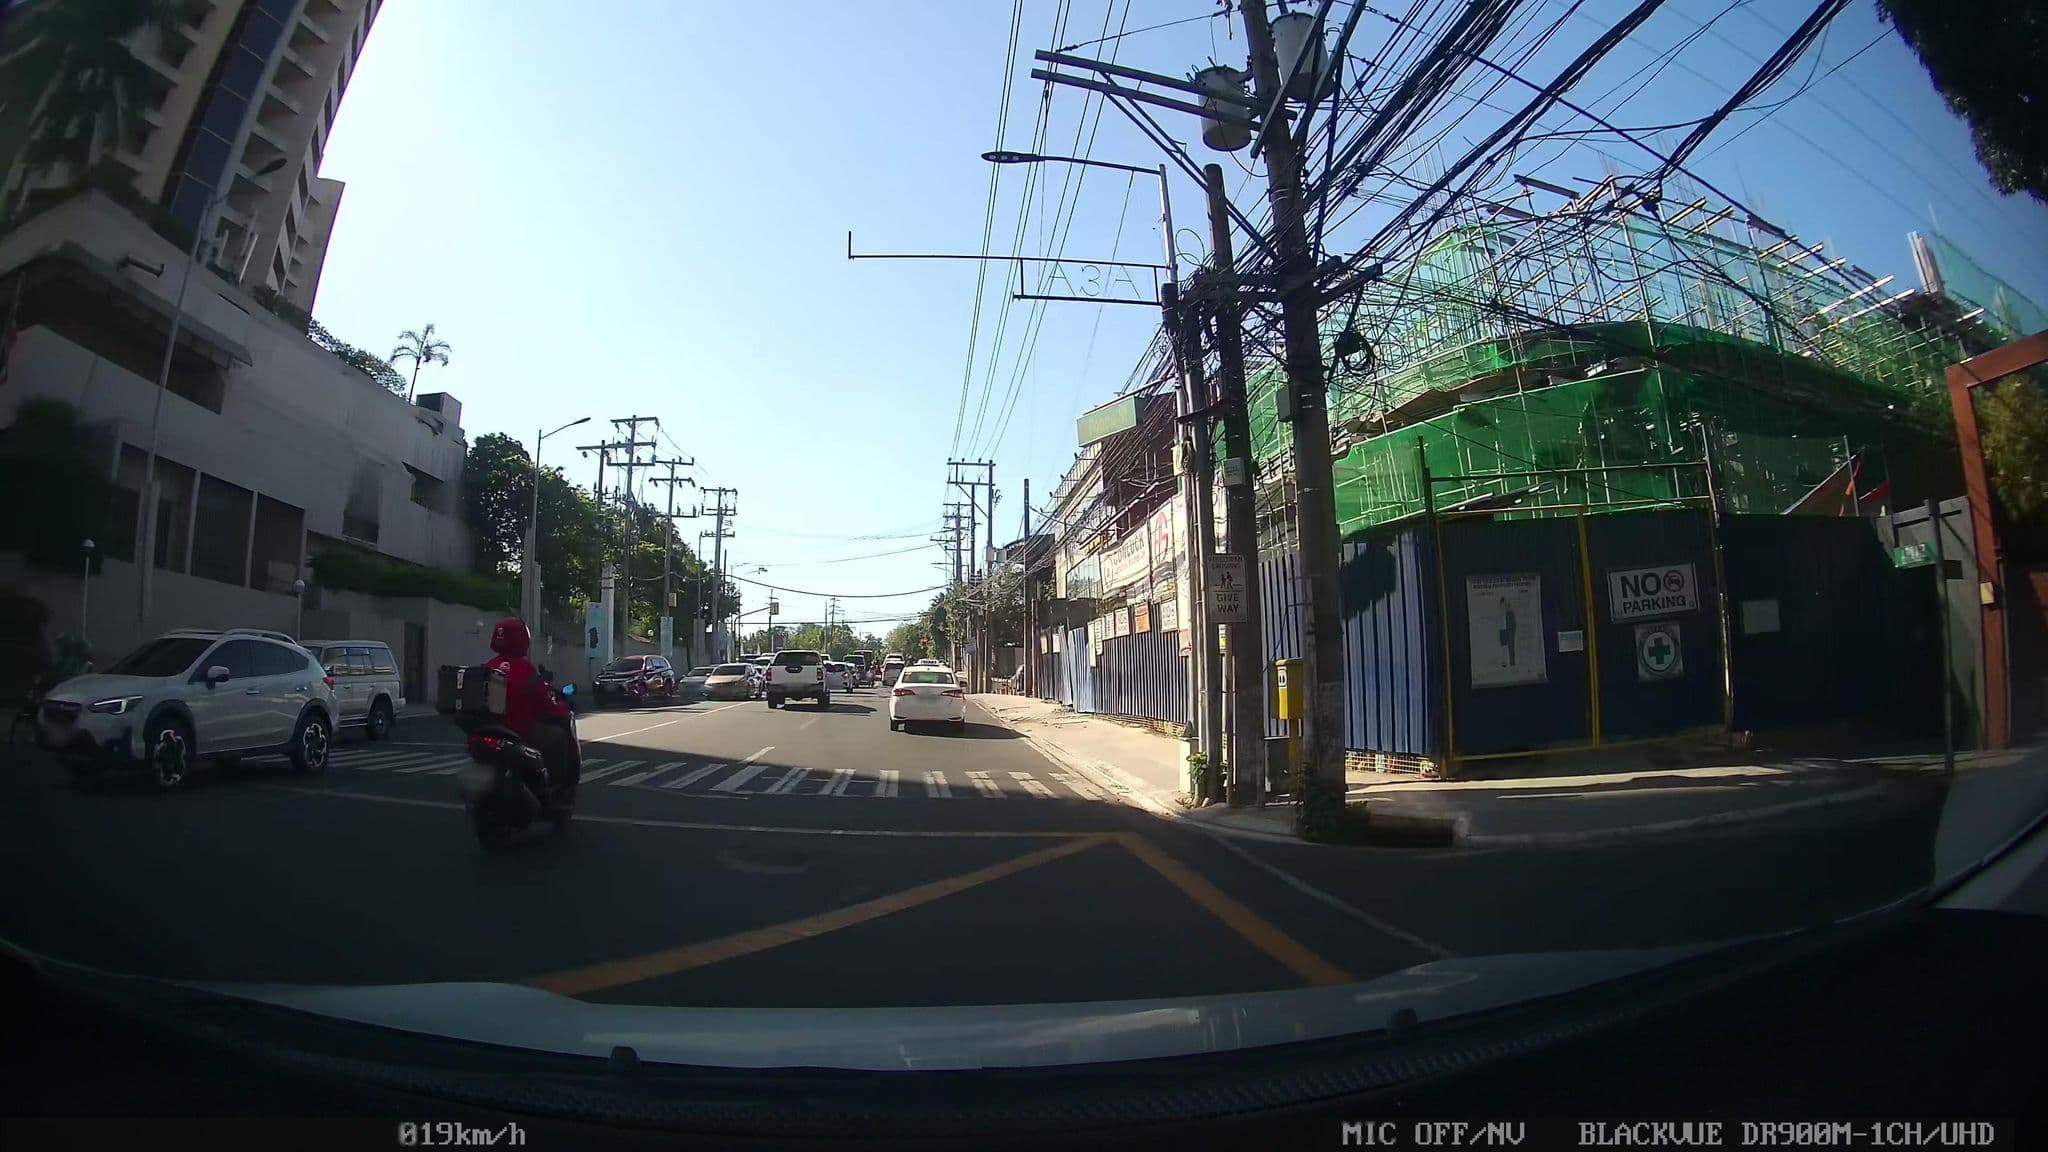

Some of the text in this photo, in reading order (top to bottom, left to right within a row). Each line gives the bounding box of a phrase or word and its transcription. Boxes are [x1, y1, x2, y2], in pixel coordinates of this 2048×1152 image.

[1620, 572, 1661, 598] NO
[1216, 593, 1240, 602] GIVE
[1623, 595, 1686, 614] PARKING
[1216, 603, 1240, 613] WAY
